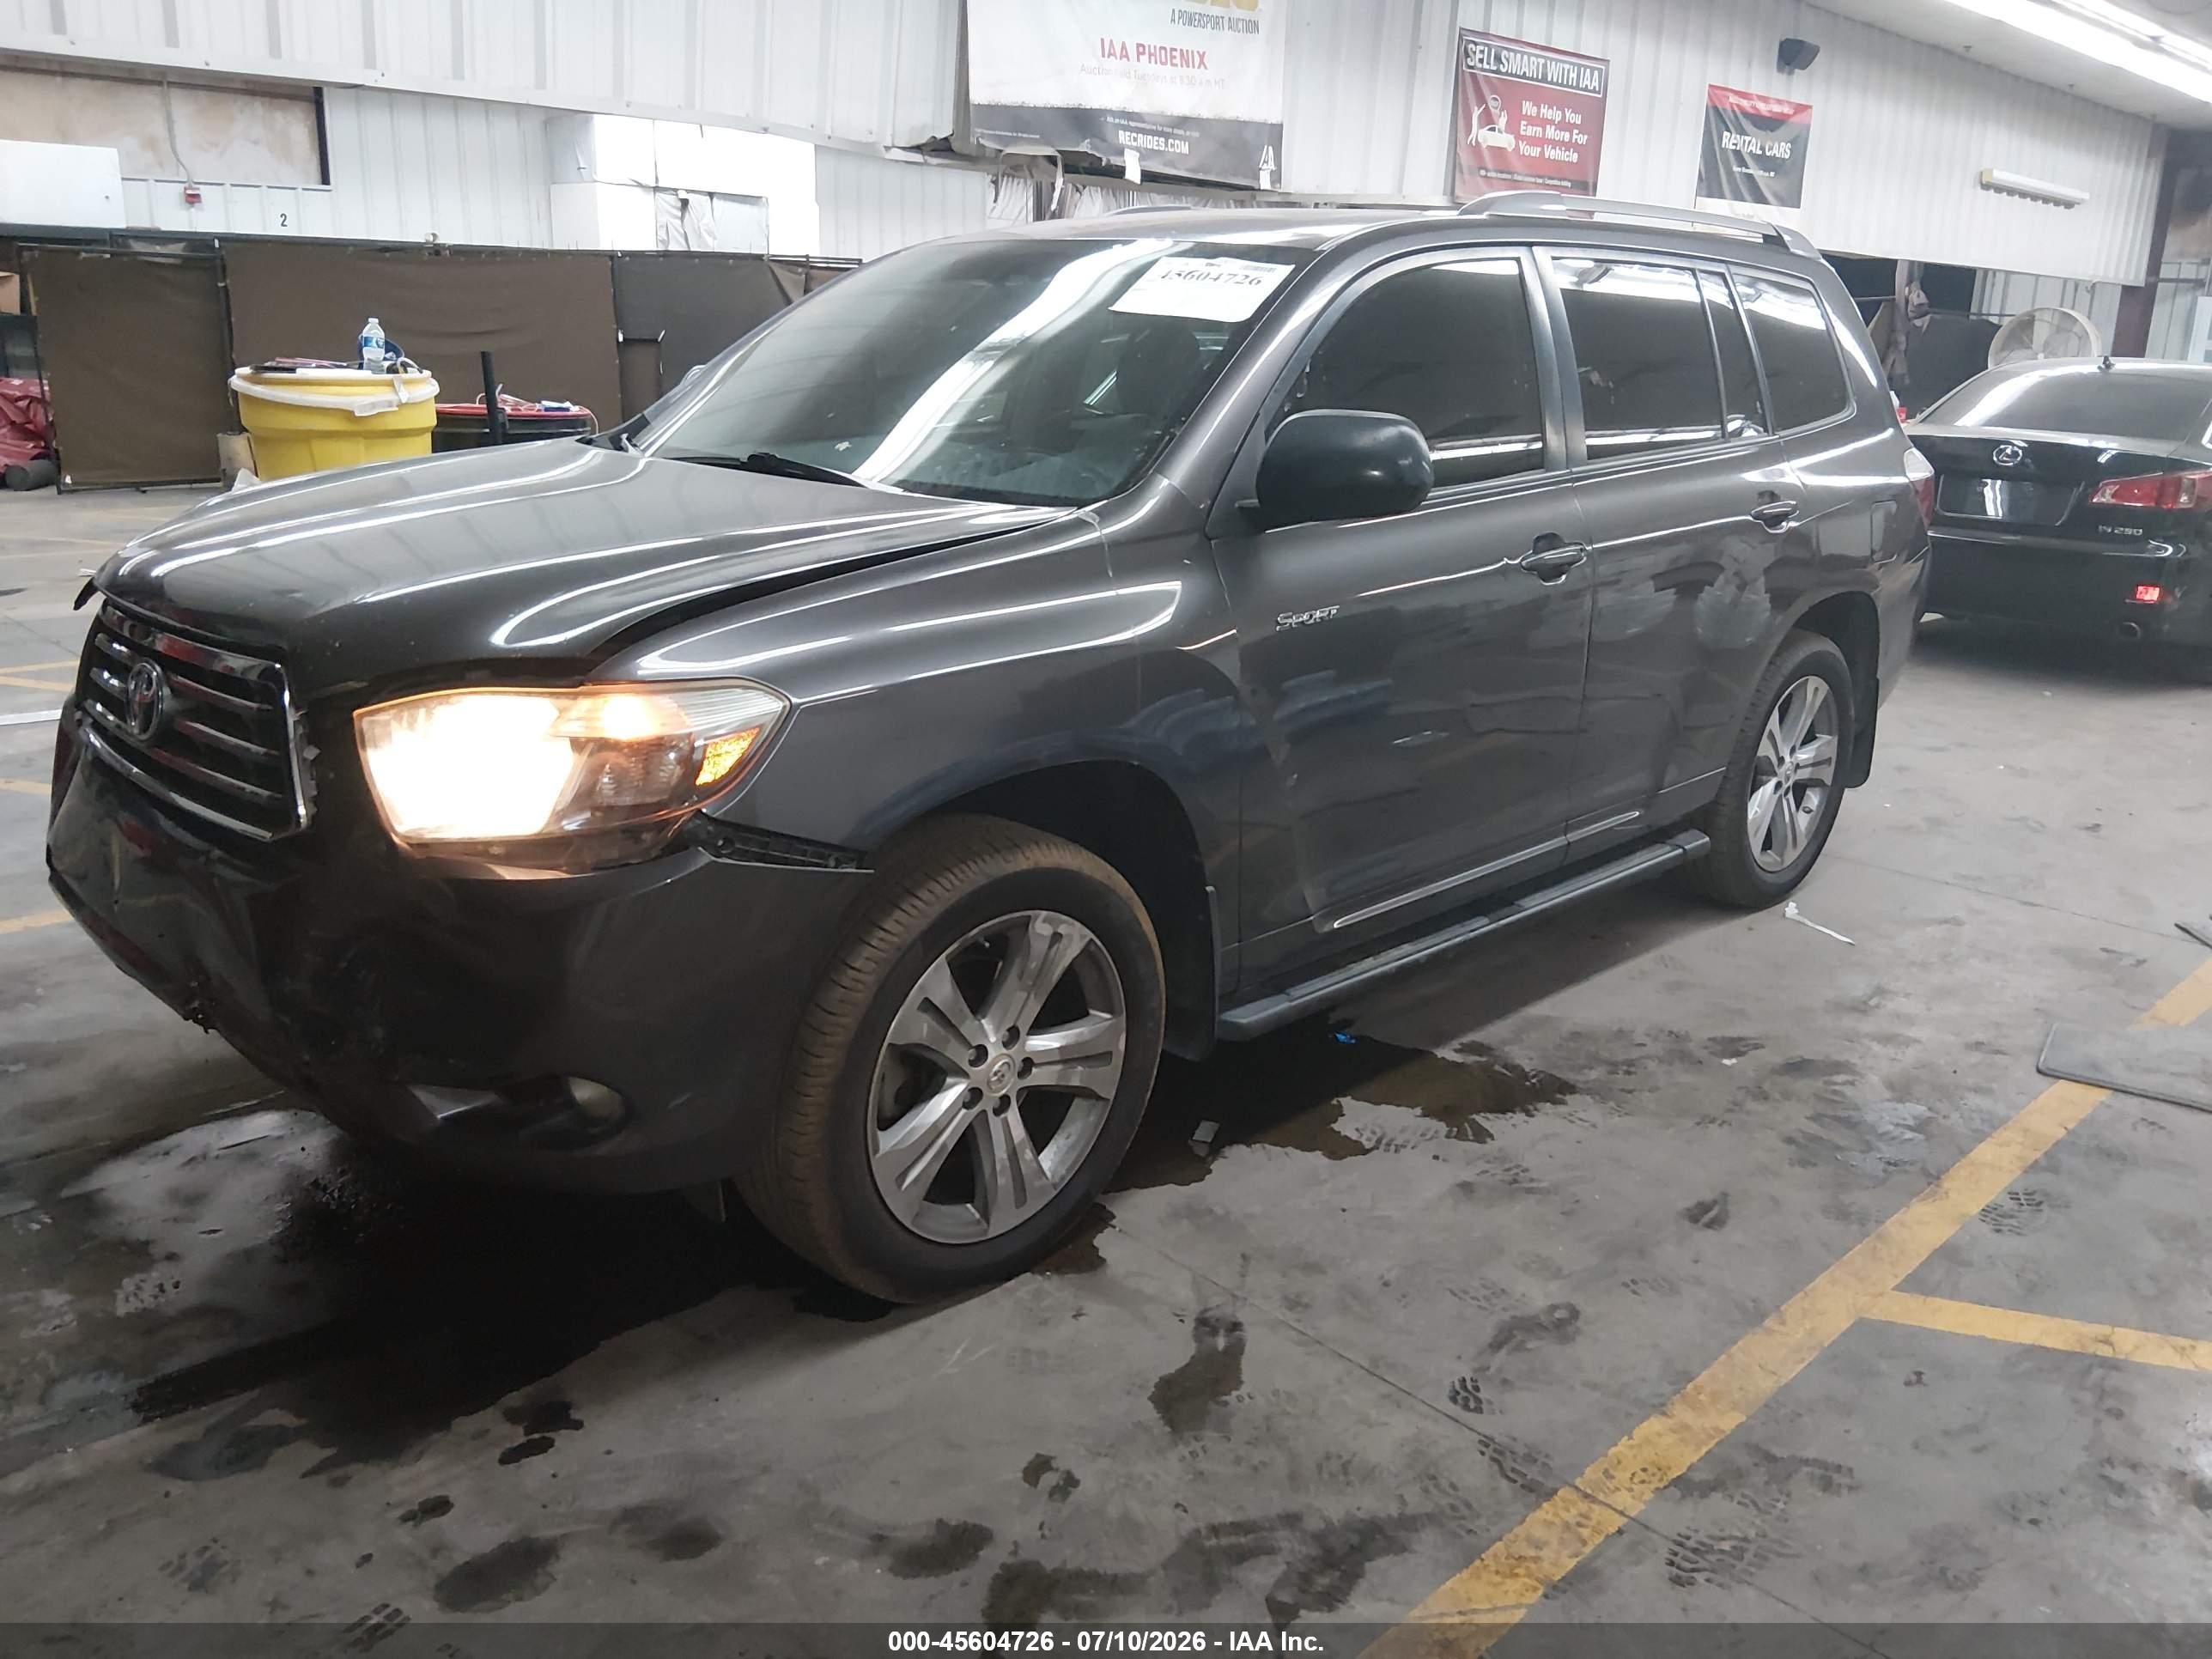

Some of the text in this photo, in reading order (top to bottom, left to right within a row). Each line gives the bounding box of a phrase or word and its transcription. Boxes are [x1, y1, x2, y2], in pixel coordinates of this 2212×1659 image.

[1170, 9, 1260, 34] A POWERSPORT AUCTION
[1100, 38, 1208, 70] IAA PHOENIX
[1468, 44, 1600, 91] SELL SMART WITH IAA
[1522, 100, 1582, 125] We Help You
[1119, 130, 1189, 155] RECRIDES.COM
[1520, 121, 1588, 144] Earn More For
[1722, 131, 1791, 159] RENTAL CARS
[1519, 141, 1578, 162] Your Vehicle
[280, 213, 289, 228] 2
